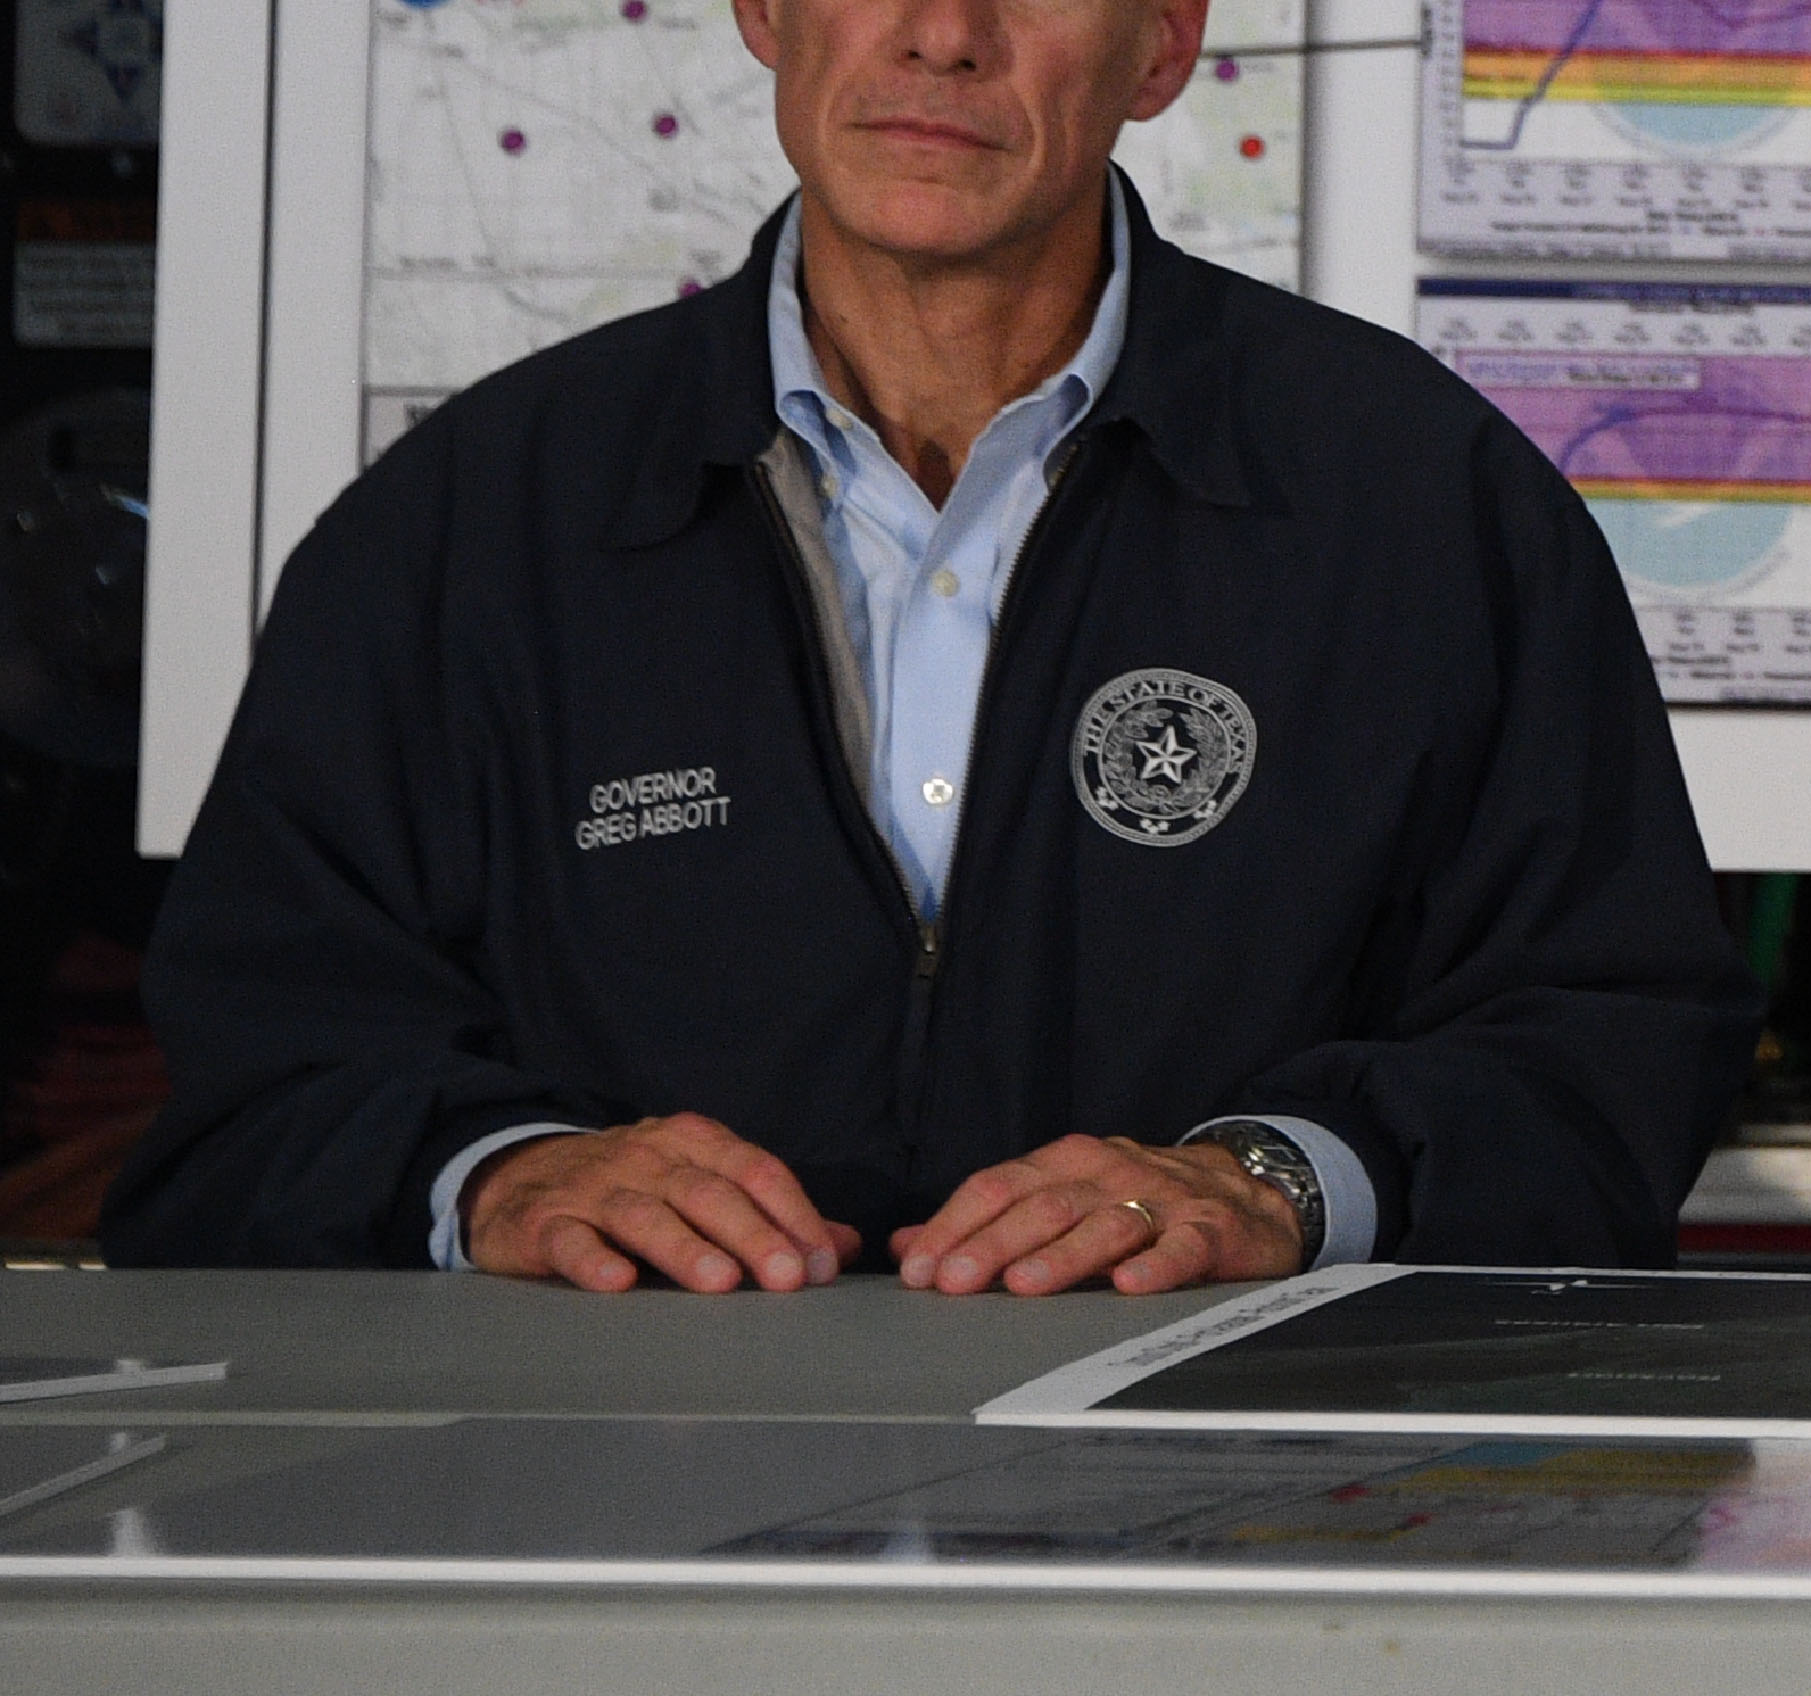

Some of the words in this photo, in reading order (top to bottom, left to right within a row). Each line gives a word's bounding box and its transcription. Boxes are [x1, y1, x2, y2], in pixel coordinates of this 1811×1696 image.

[1109, 679, 1186, 708] STATE
[1188, 686, 1222, 707] OF
[589, 766, 717, 814] GOVERNOR
[575, 811, 637, 850] GREG
[638, 796, 731, 838] ABBOTT
